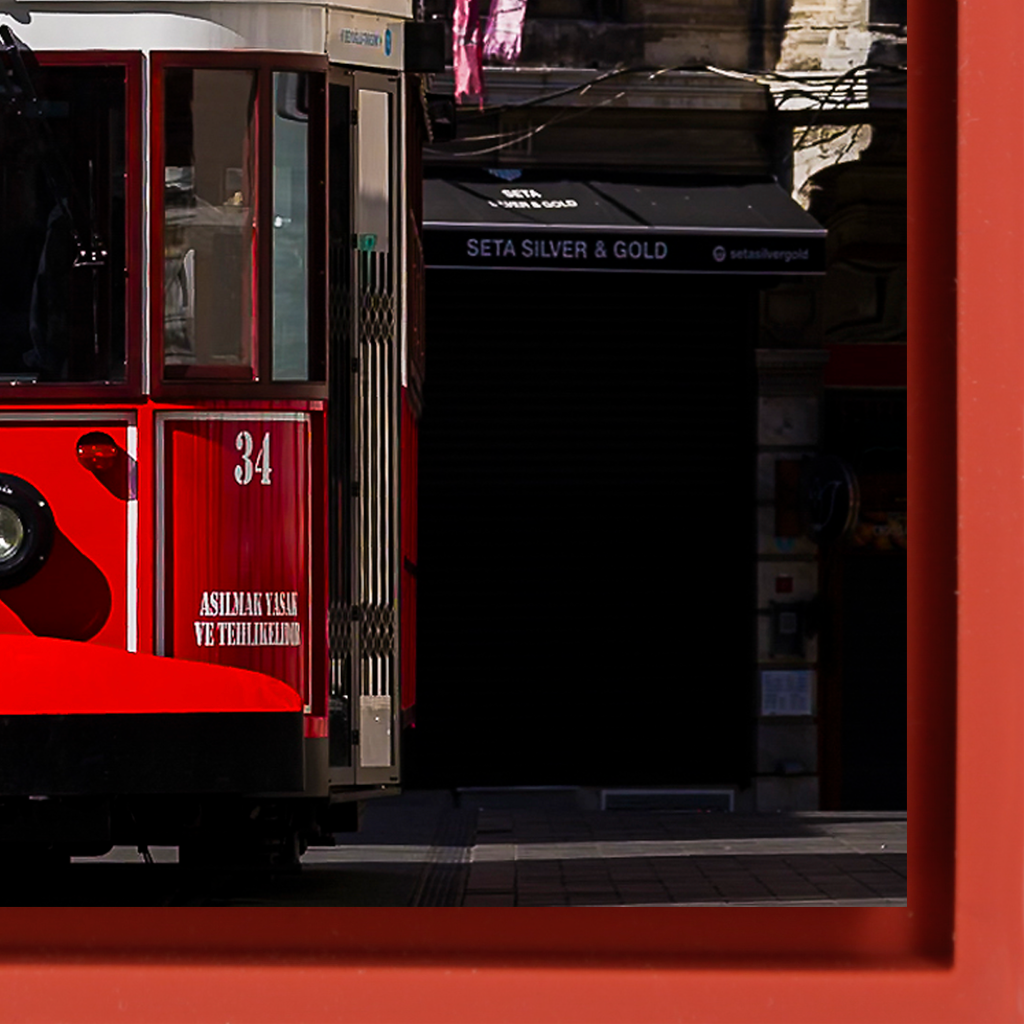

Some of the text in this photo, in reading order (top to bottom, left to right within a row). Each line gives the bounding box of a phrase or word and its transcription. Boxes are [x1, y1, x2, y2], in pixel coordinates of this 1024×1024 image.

[501, 189, 542, 199] SETA
[542, 199, 579, 209] GOLD
[466, 237, 669, 260] SETA SILVER & GOLD
[233, 430, 272, 486] 34
[199, 591, 299, 617] ASILMAK YASAK
[193, 621, 215, 647] VE
